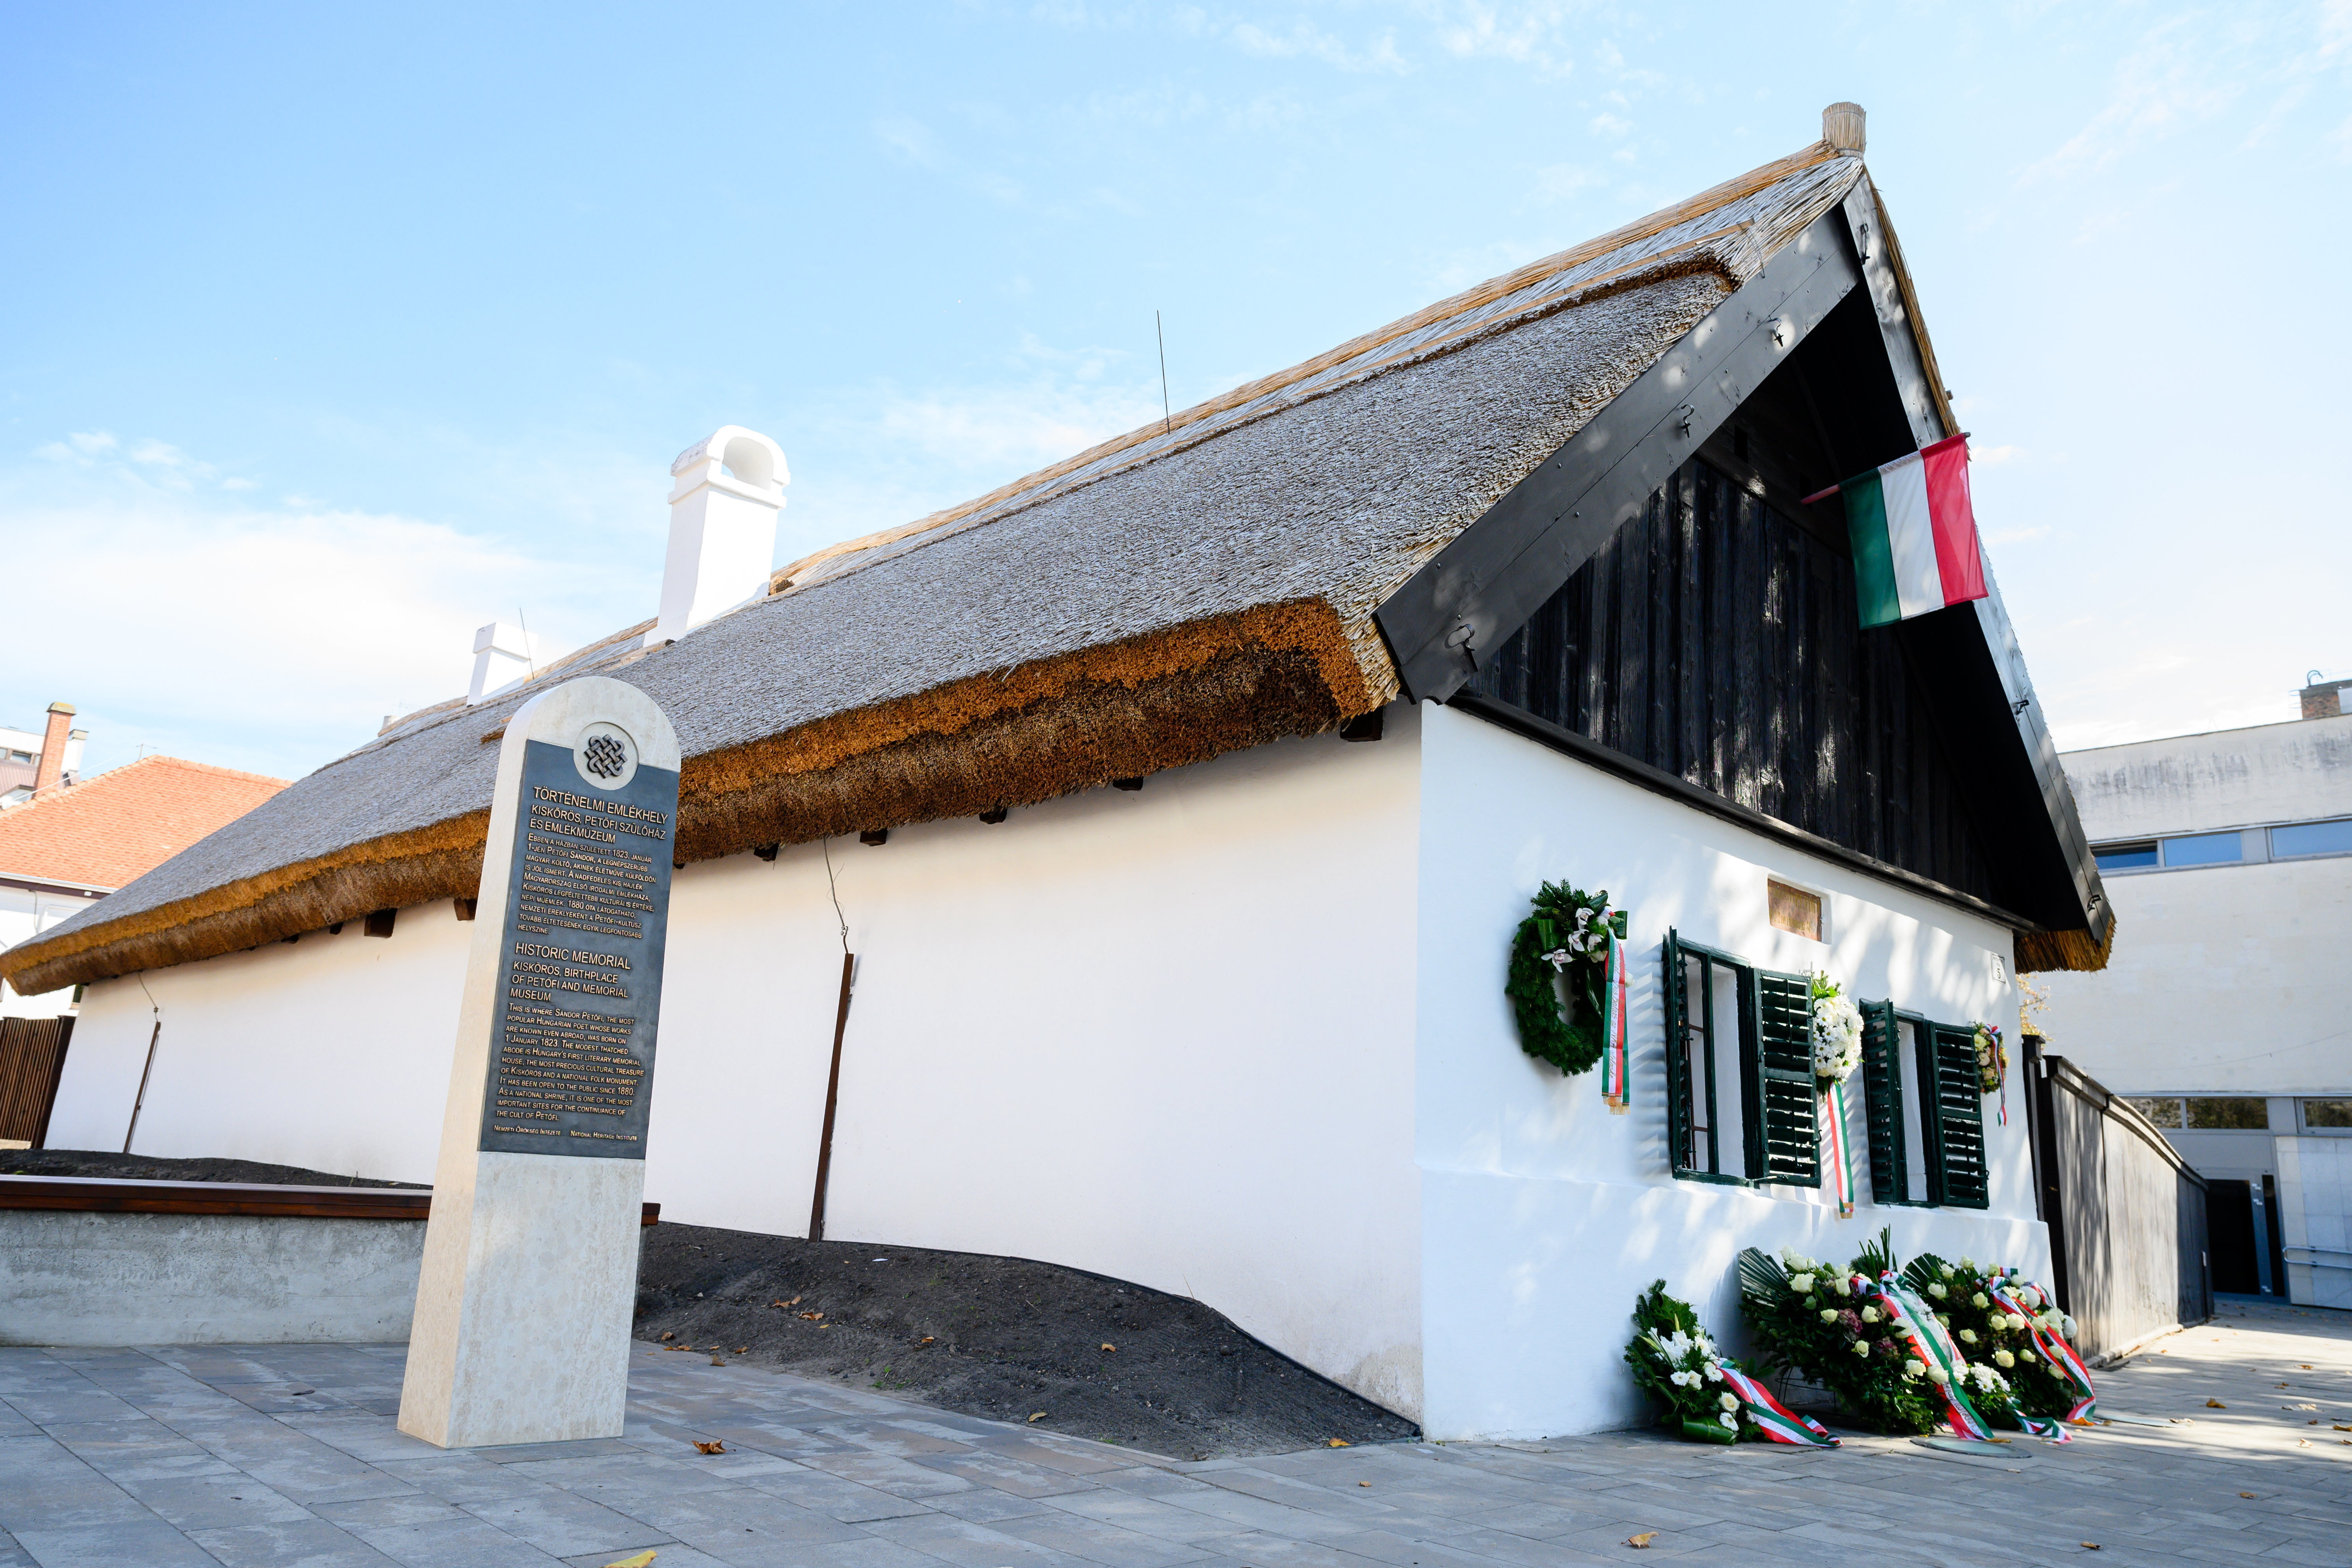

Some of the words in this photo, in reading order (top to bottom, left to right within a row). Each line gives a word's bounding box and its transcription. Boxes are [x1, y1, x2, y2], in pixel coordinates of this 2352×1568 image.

[531, 804, 581, 824] KISKŐRÖS,
[584, 815, 617, 830] PETŐFI
[607, 802, 668, 824] EMLÉKHELY
[530, 816, 543, 829] ÉS
[544, 821, 615, 843] EMLÉKMÚZEUM
[515, 941, 569, 960] HISTORIC
[572, 950, 630, 969] MEMORIAL
[564, 967, 618, 983] BIRTHPLACE
[1997, 968, 2001, 979] 5
[510, 987, 551, 1001] MUSEUM
[512, 974, 525, 984] OF
[527, 976, 560, 989] PETŐFI
[560, 981, 580, 991] AND
[582, 983, 628, 998] MEMORIAL
